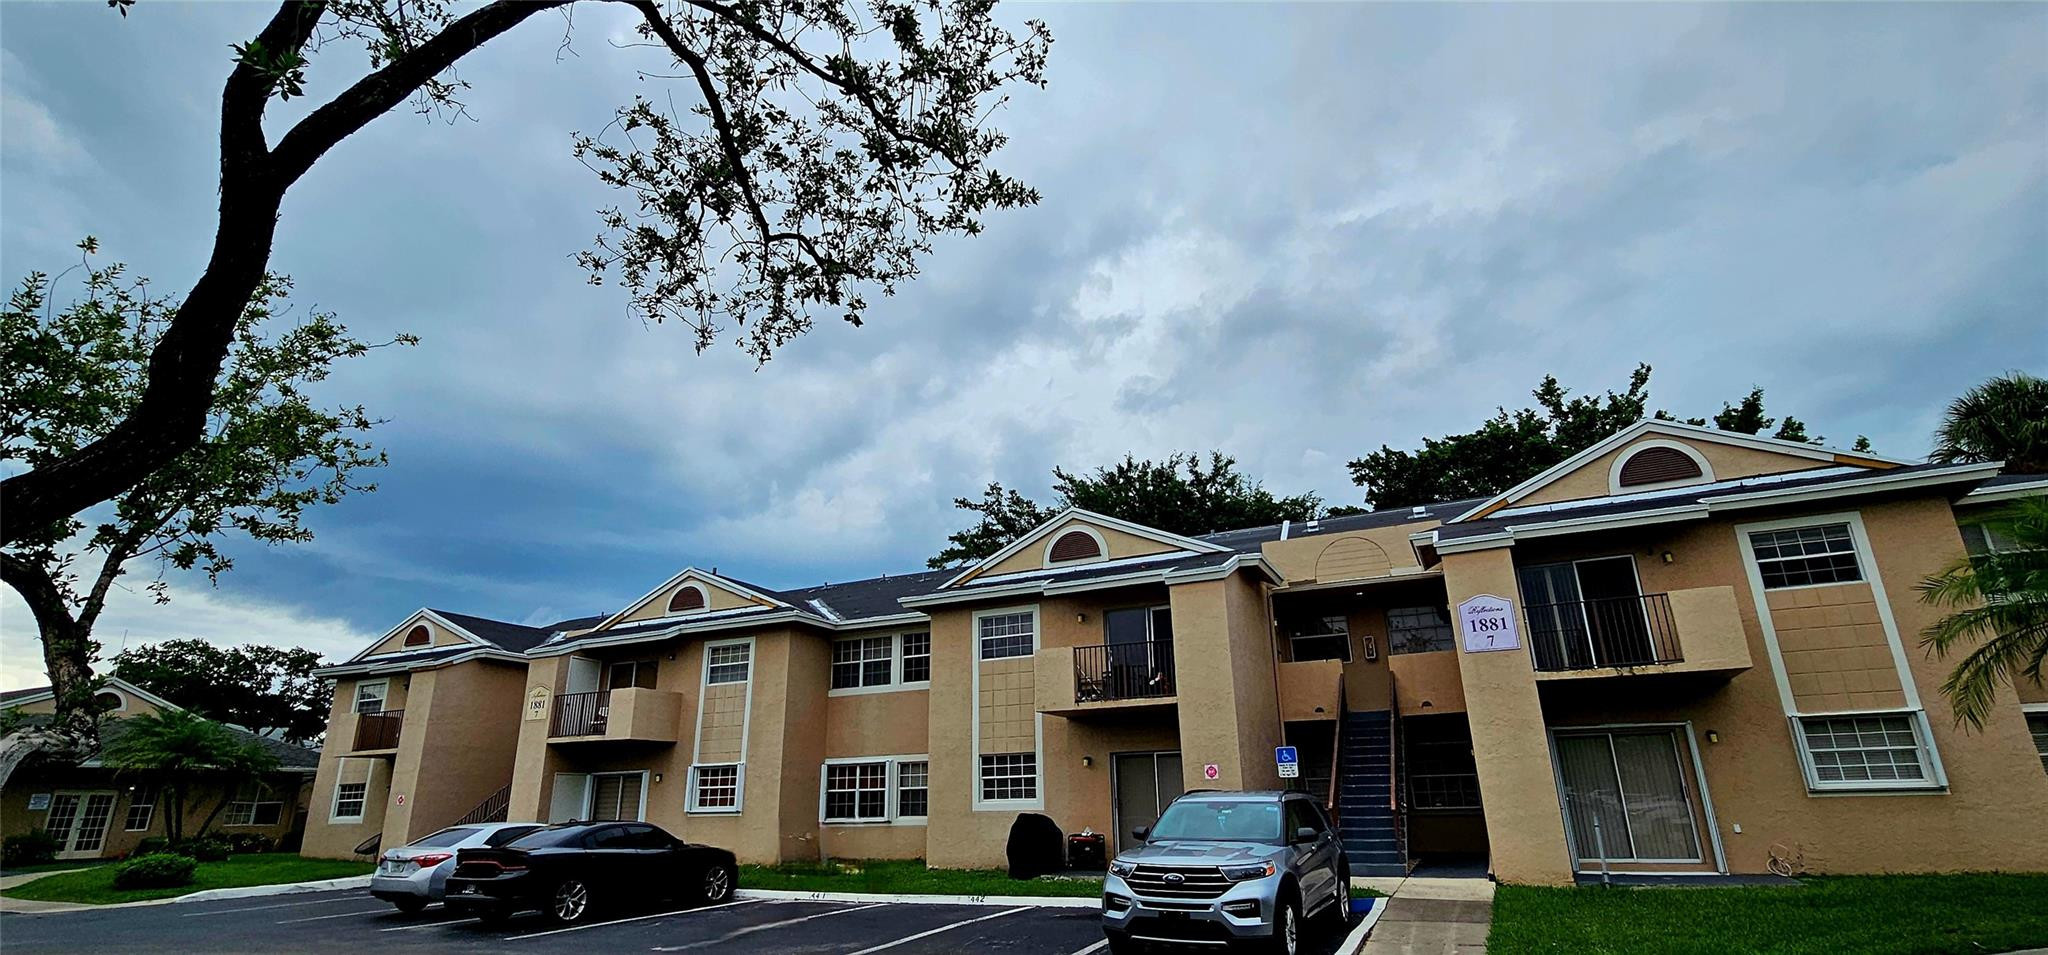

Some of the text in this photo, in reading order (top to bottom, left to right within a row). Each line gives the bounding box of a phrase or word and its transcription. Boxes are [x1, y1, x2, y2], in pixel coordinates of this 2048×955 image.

[1470, 617, 1507, 632] 1881
[1487, 635, 1494, 647] 7
[530, 700, 545, 709] 1881
